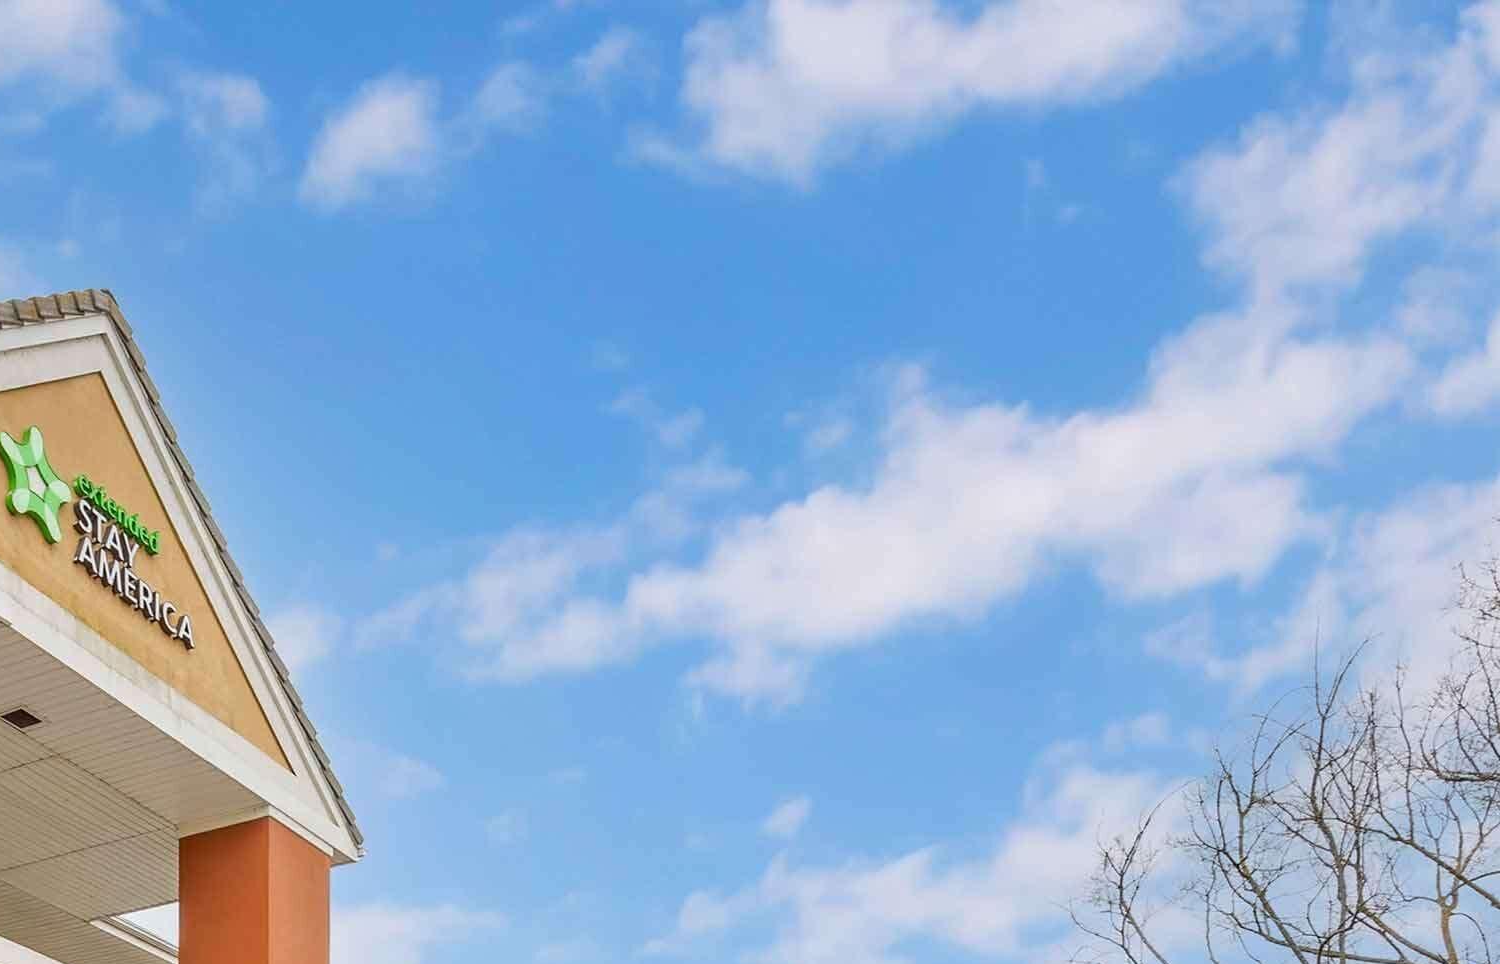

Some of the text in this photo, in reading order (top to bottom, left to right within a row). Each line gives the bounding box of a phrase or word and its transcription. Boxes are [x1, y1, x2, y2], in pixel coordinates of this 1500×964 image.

[74, 474, 160, 555] extended
[74, 498, 139, 568] STAY
[74, 537, 194, 650] AMERICA
